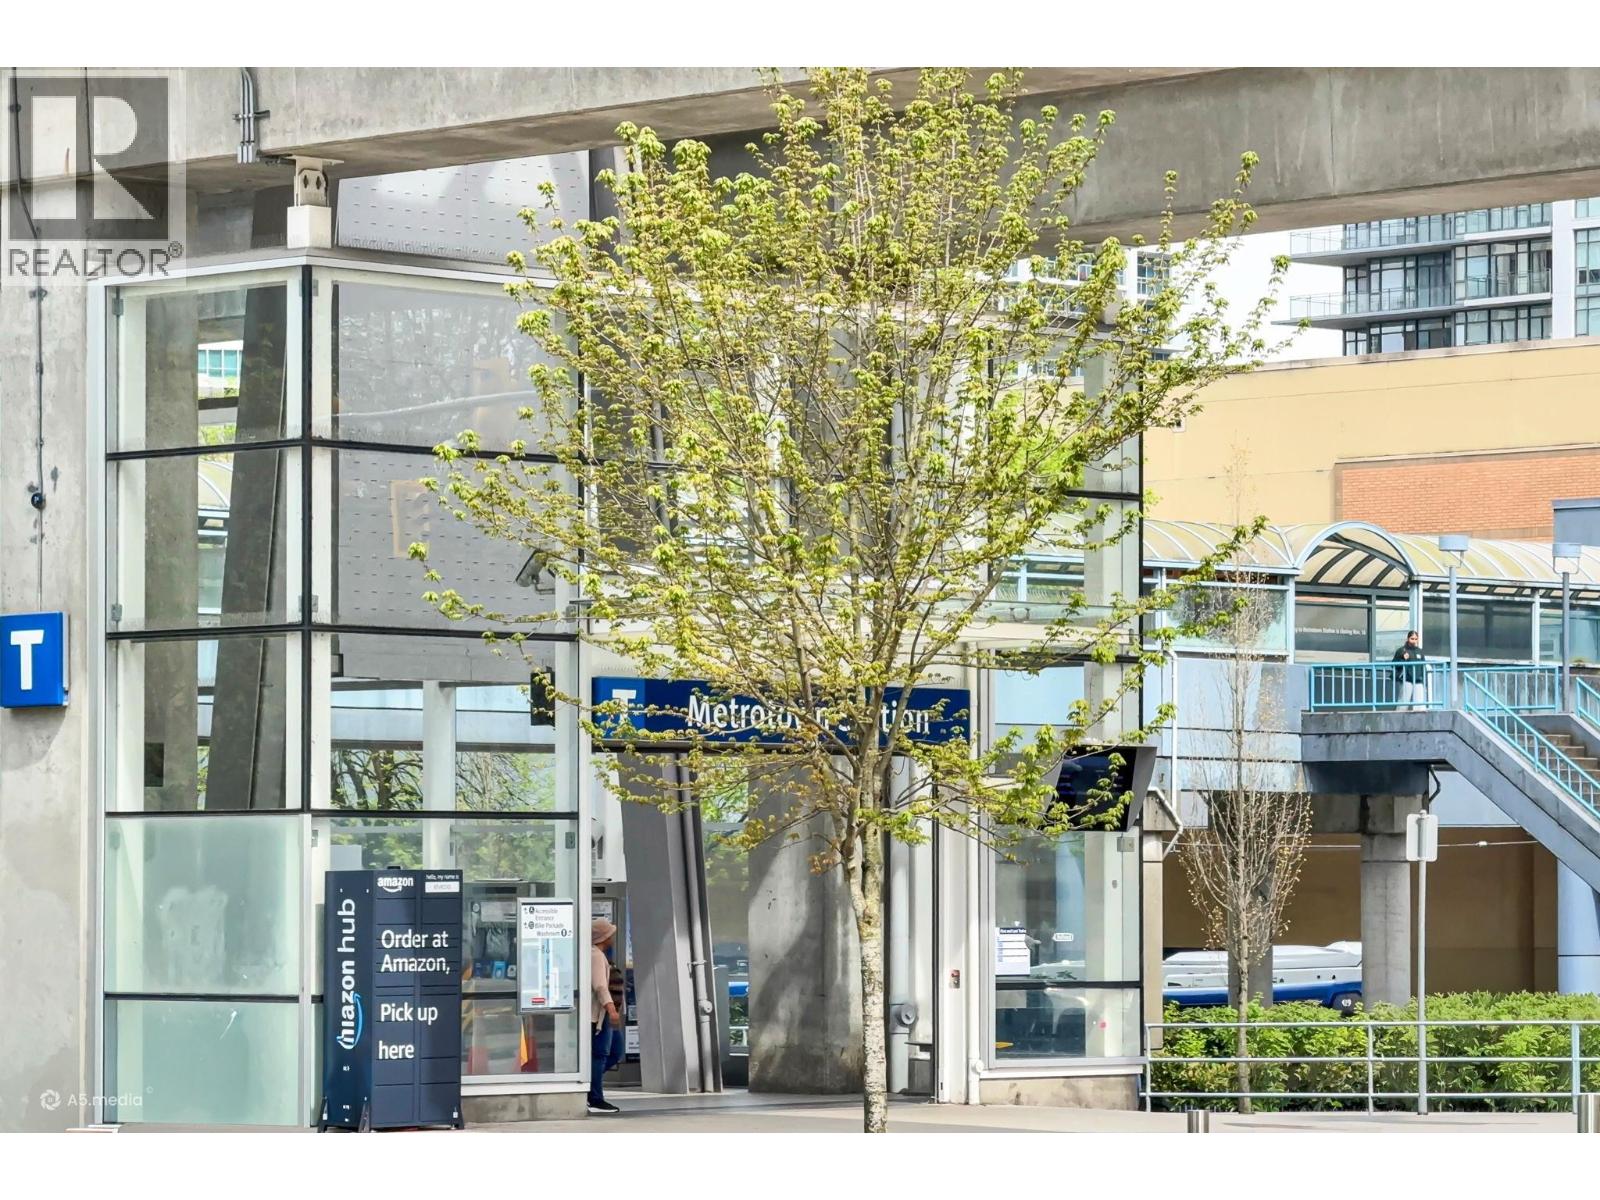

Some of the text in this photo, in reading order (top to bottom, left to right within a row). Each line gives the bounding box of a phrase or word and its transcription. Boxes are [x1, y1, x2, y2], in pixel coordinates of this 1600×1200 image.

[10, 629, 44, 690] T
[837, 698, 930, 735] tion
[377, 876, 414, 888] amazon
[381, 929, 449, 948] Order at
[337, 898, 357, 1050] mazon hub
[380, 954, 450, 975] Amazon,
[380, 1002, 438, 1025] Pick up
[378, 1040, 415, 1060] here
